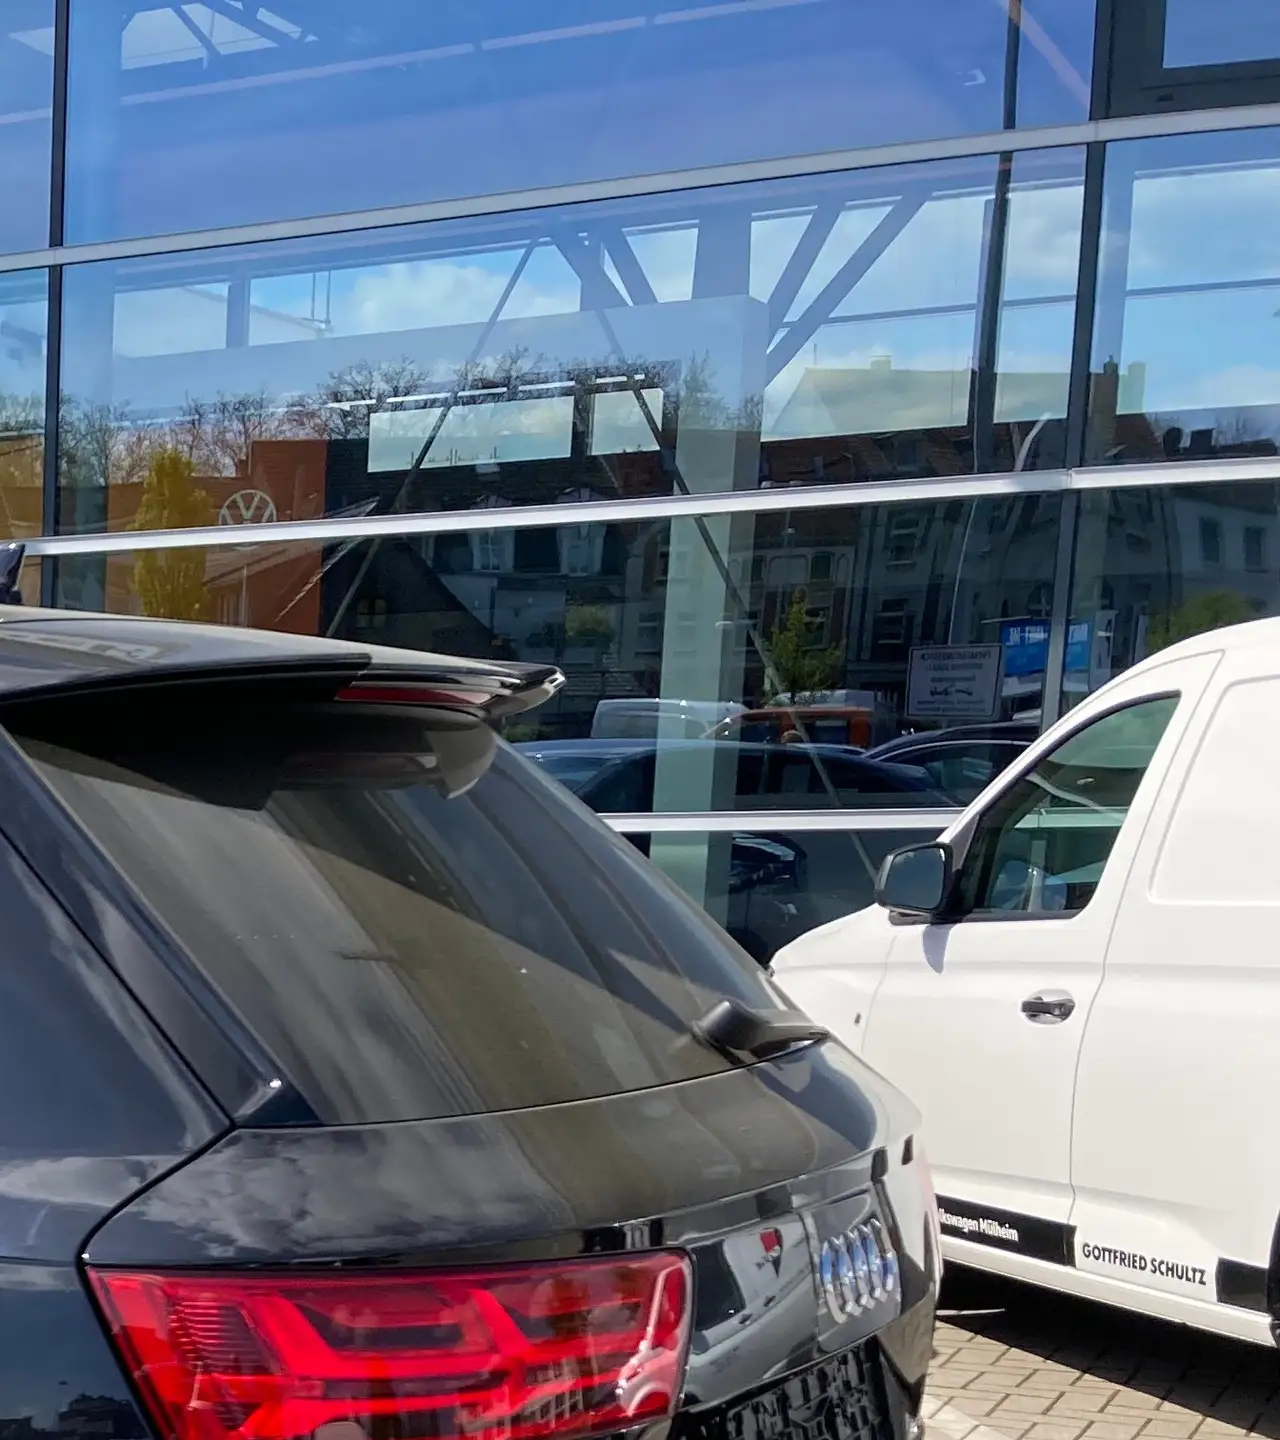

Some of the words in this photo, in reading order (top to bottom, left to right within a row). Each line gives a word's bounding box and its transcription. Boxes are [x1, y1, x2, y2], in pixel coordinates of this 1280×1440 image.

[938, 1207, 979, 1234] lkswagen
[979, 1217, 1020, 1243] Mülheim
[1082, 1241, 1148, 1272] GOTTFRIED
[1149, 1257, 1207, 1286] SCHULTZ
